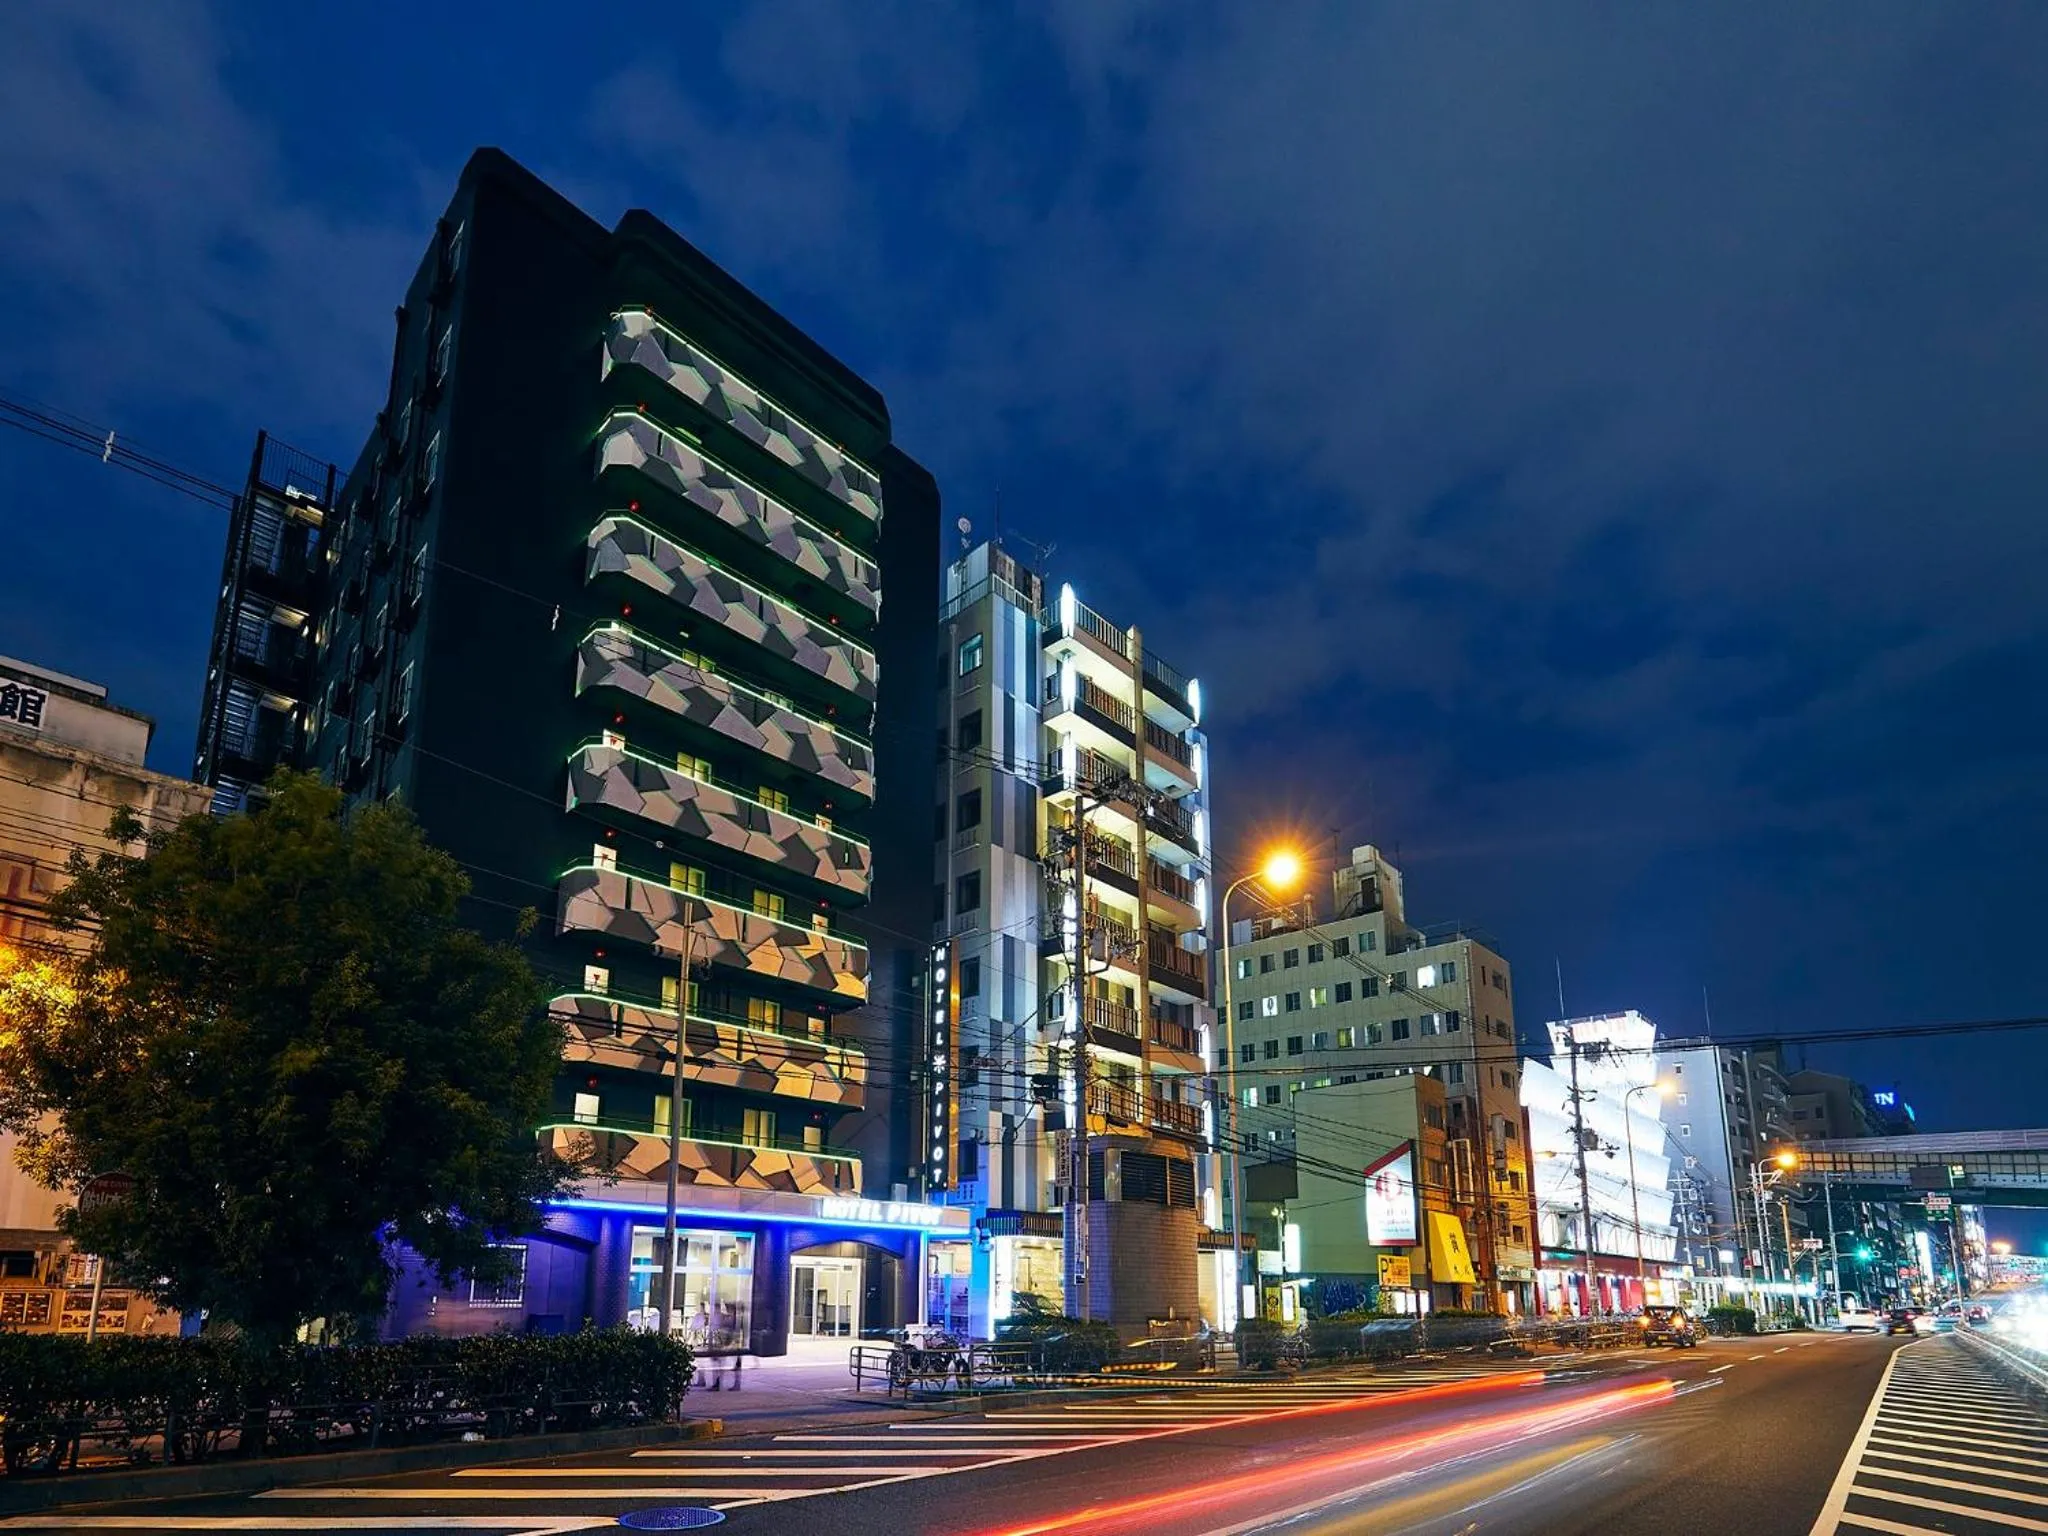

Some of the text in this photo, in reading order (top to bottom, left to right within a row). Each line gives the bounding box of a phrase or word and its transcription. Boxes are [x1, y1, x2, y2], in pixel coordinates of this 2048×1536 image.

[0, 682, 47, 727] 館
[932, 947, 946, 1183] HOTEL PIVOT
[823, 1197, 943, 1226] HOTEL PIVOT
